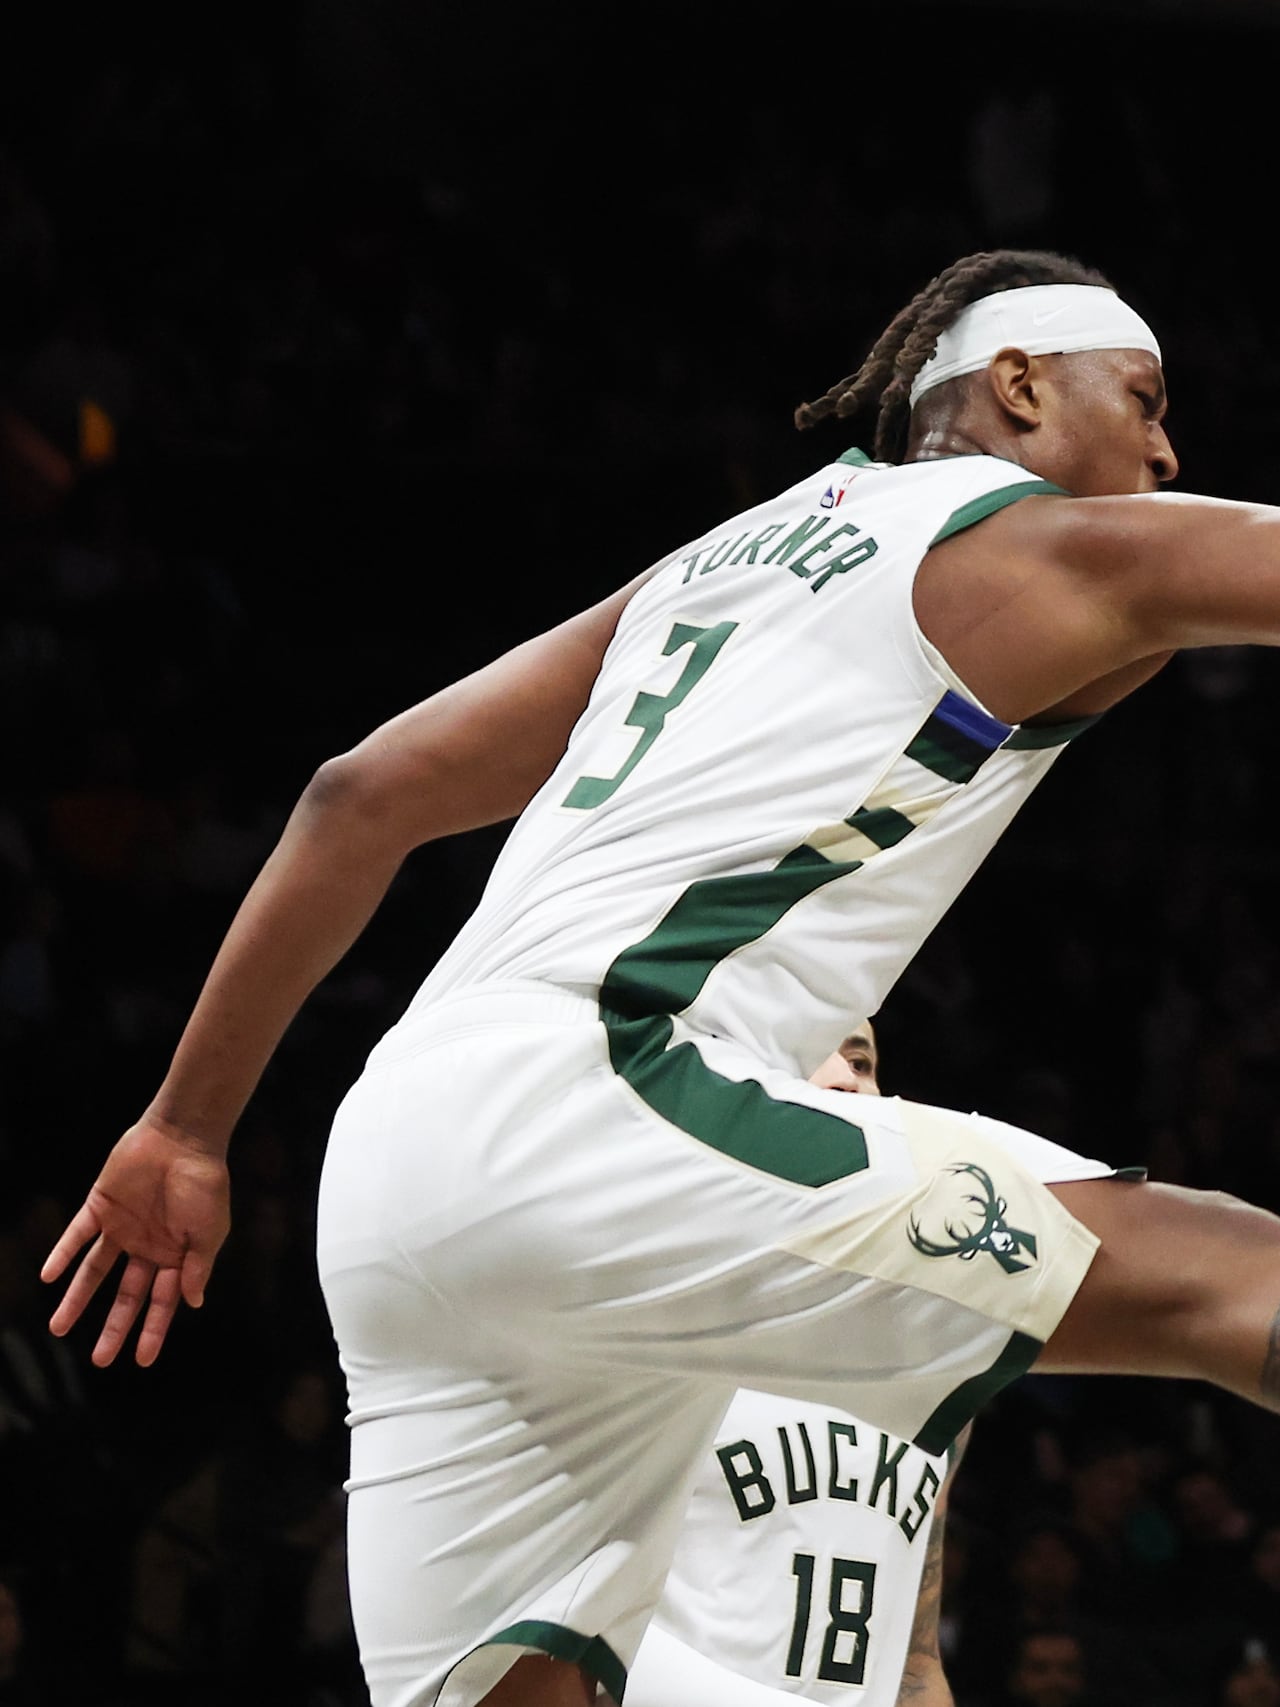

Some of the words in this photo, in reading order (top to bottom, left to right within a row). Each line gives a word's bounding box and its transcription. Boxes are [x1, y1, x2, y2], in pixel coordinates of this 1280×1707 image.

[681, 514, 879, 594] TURNER
[560, 619, 741, 809] 3
[714, 1420, 941, 1545] BUCKS
[785, 1552, 878, 1686] 18
